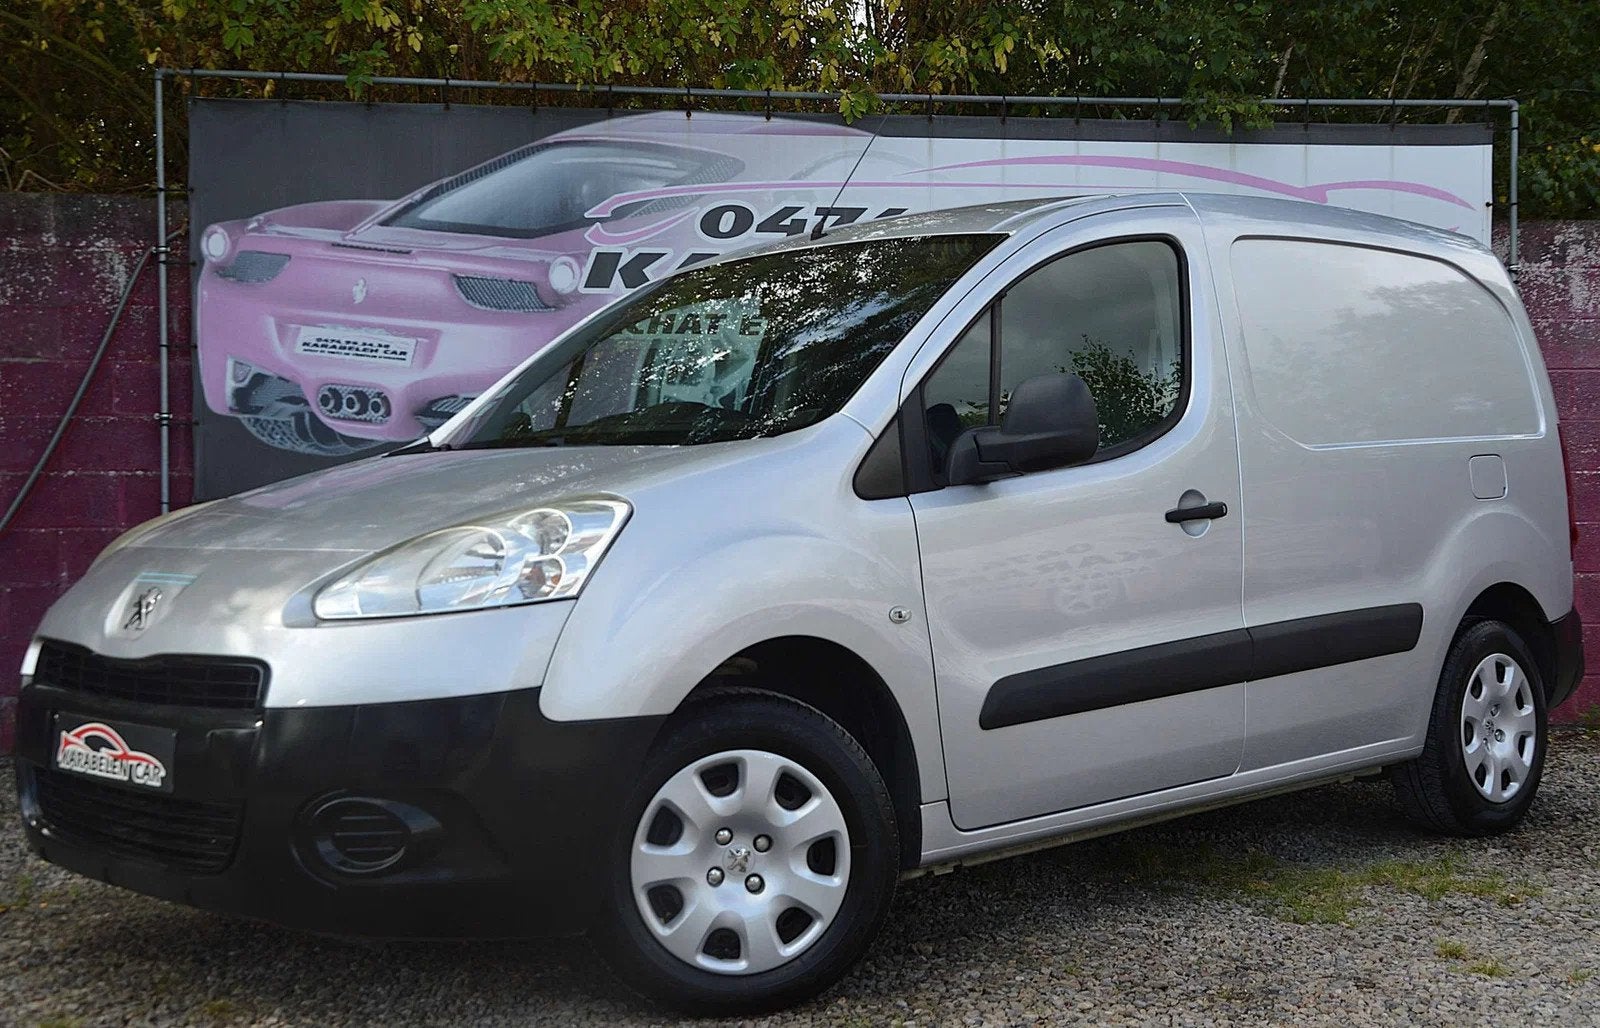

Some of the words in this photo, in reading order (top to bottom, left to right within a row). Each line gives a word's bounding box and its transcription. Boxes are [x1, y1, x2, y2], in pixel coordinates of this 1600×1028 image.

[700, 205, 909, 239] 047
[302, 341, 379, 354] KARABELEN
[60, 748, 129, 779] KARABELEN
[131, 763, 162, 786] CAR
